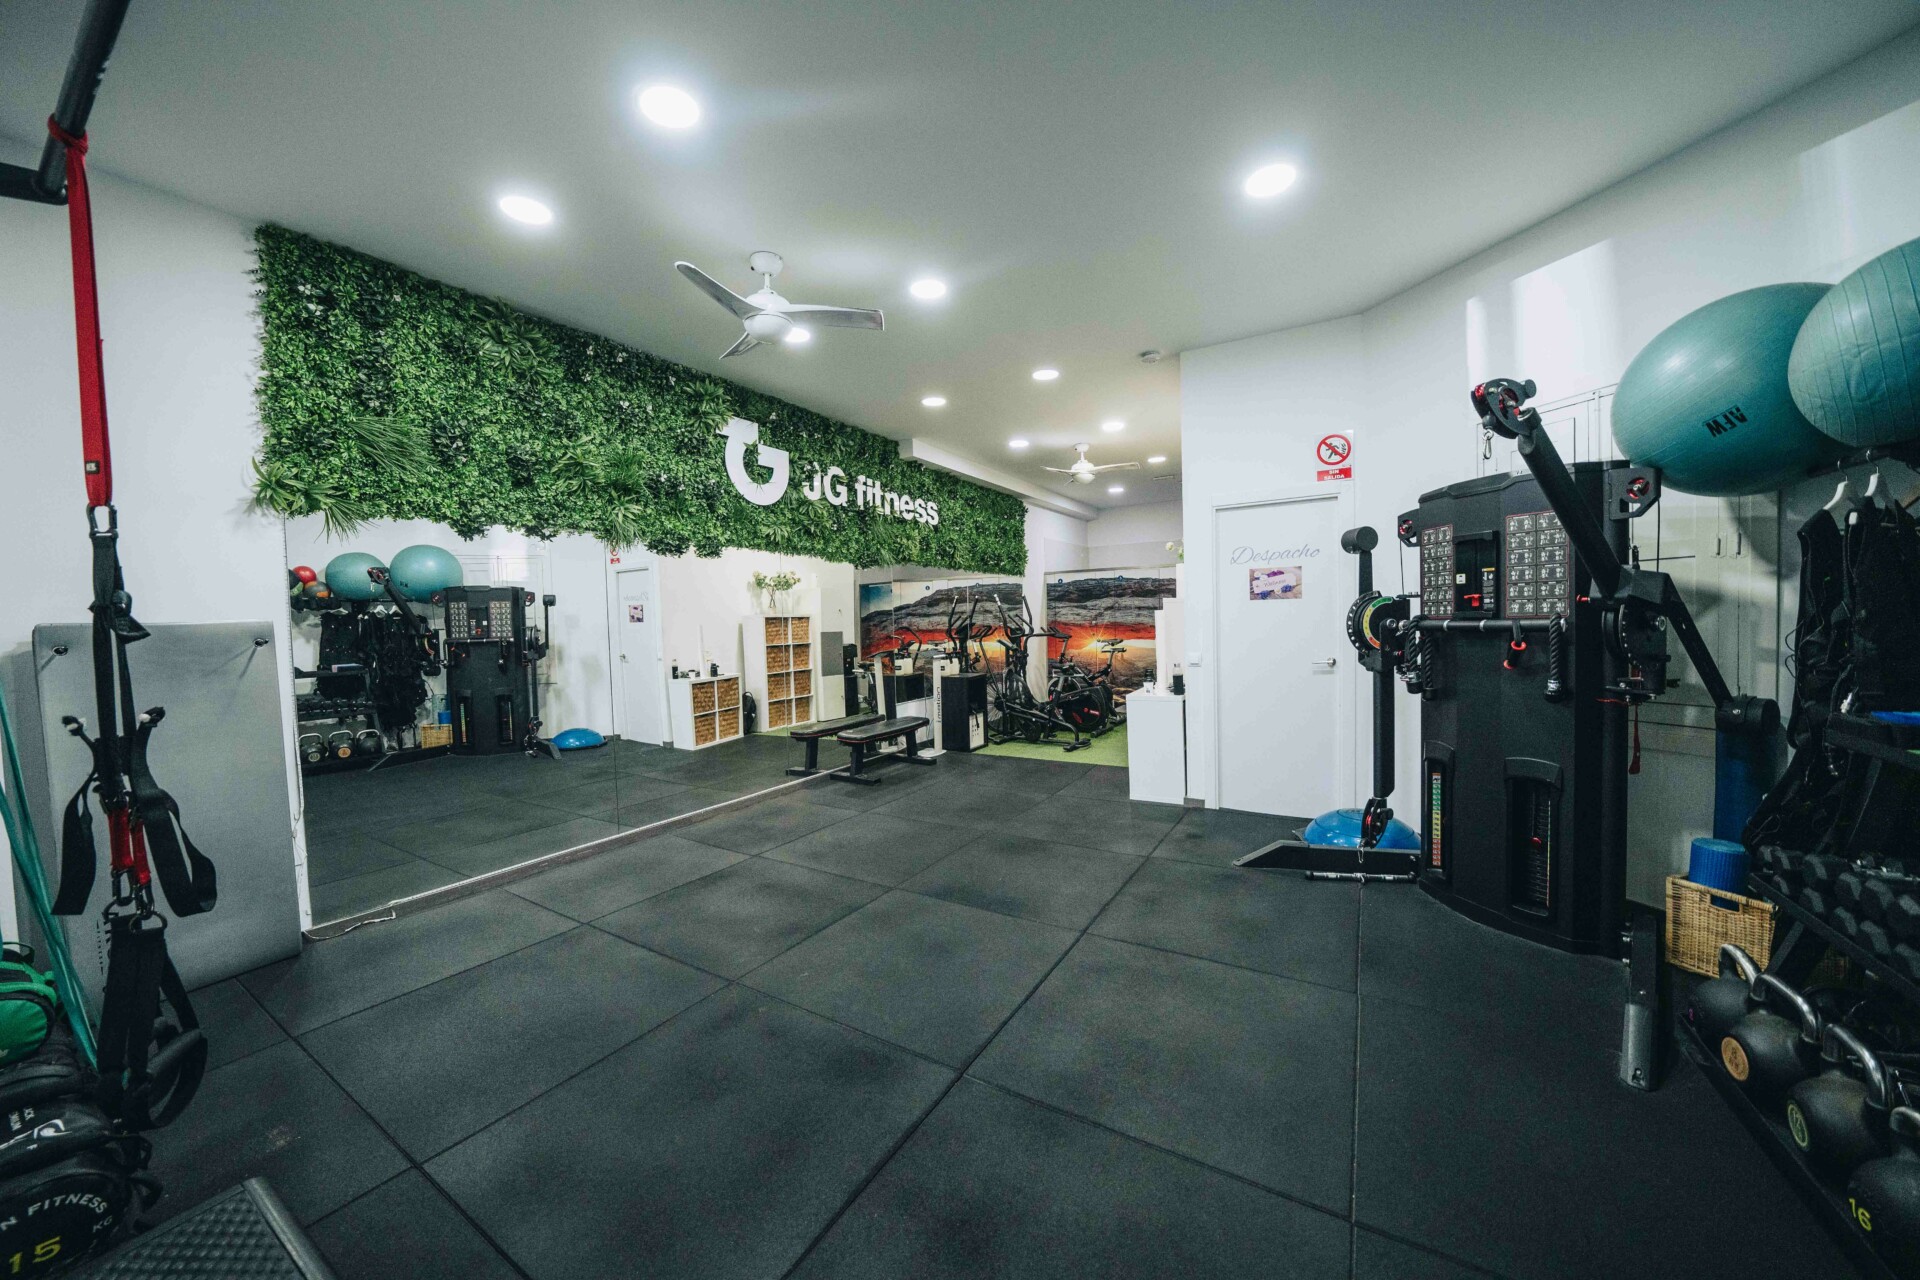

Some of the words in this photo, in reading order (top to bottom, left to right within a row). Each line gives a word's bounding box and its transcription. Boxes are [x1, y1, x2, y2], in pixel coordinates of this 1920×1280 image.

[1704, 406, 1748, 438] AFW
[1323, 473, 1345, 481] SALIDA
[803, 461, 848, 507] JG
[855, 474, 939, 526] fitness
[1230, 543, 1320, 565] Despacho
[27, 1192, 108, 1216] FITNESS
[1849, 1197, 1873, 1232] 16
[9, 1235, 61, 1274] 15
